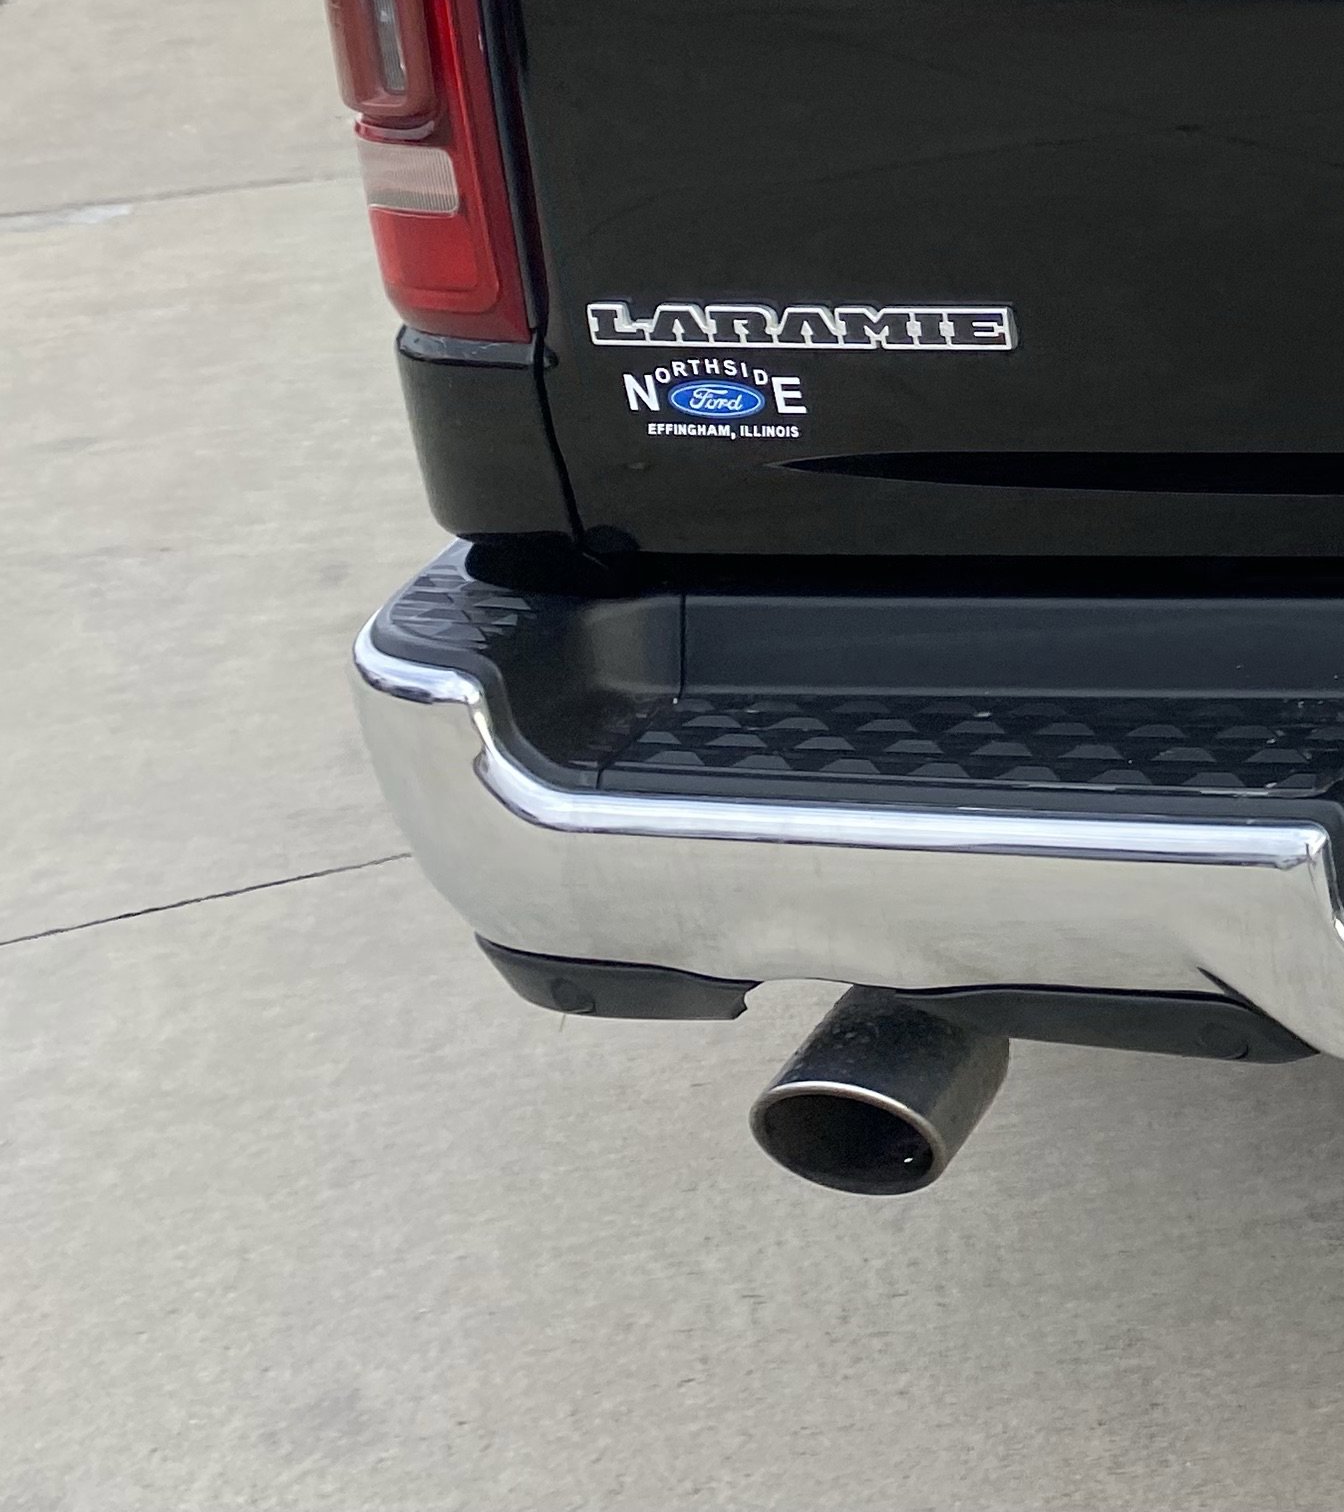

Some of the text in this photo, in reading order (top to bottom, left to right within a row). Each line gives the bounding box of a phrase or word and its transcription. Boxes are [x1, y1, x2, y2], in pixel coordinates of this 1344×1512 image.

[587, 302, 1017, 350] LARAMIE
[688, 386, 744, 412] Ford
[647, 423, 800, 439] EFFINGHAM, ILLINOIS
